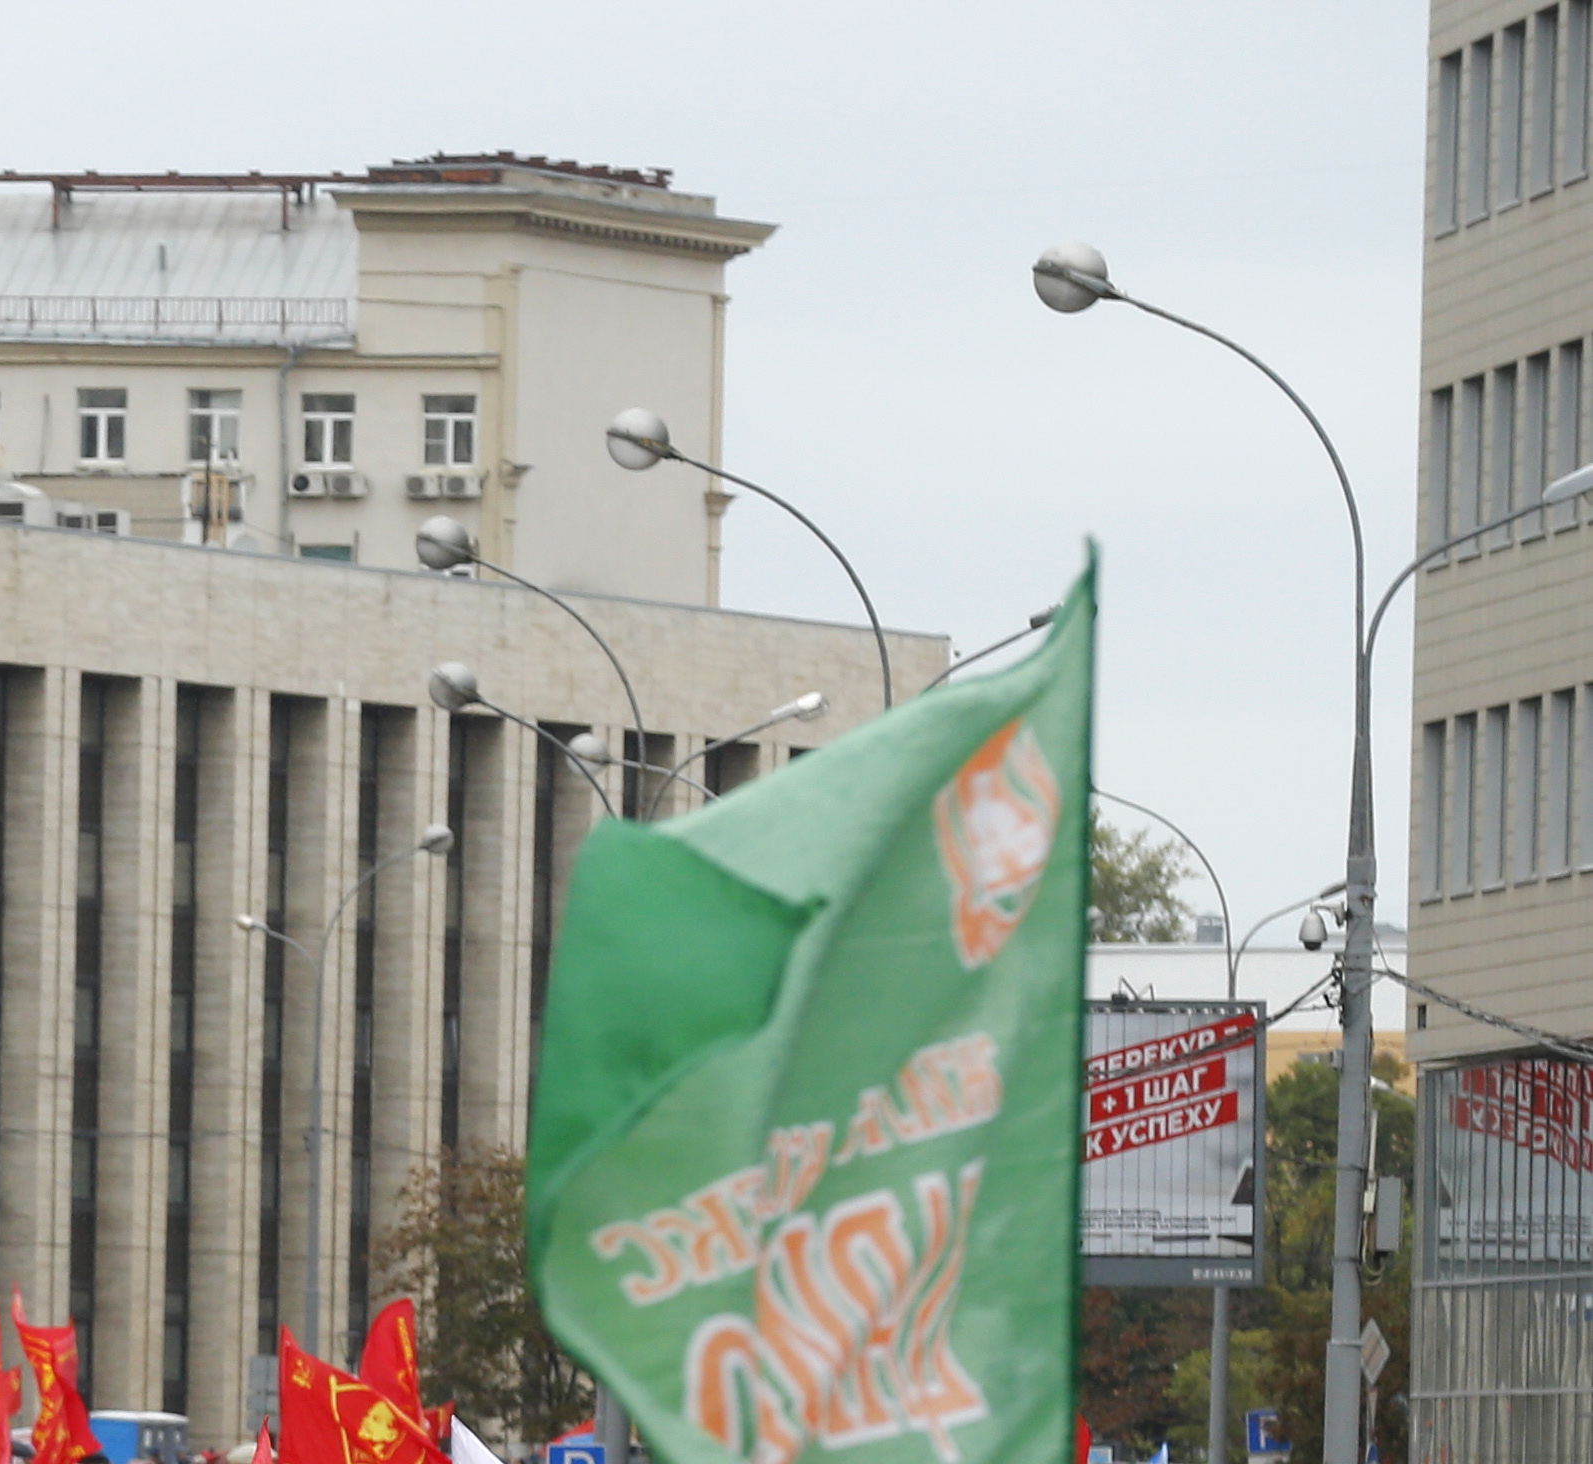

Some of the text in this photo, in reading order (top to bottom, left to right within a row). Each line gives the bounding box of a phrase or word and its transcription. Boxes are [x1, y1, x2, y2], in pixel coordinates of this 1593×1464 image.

[1145, 1066, 1209, 1104] ШАГ
[1085, 1099, 1222, 1157] К УСПЕХУ
